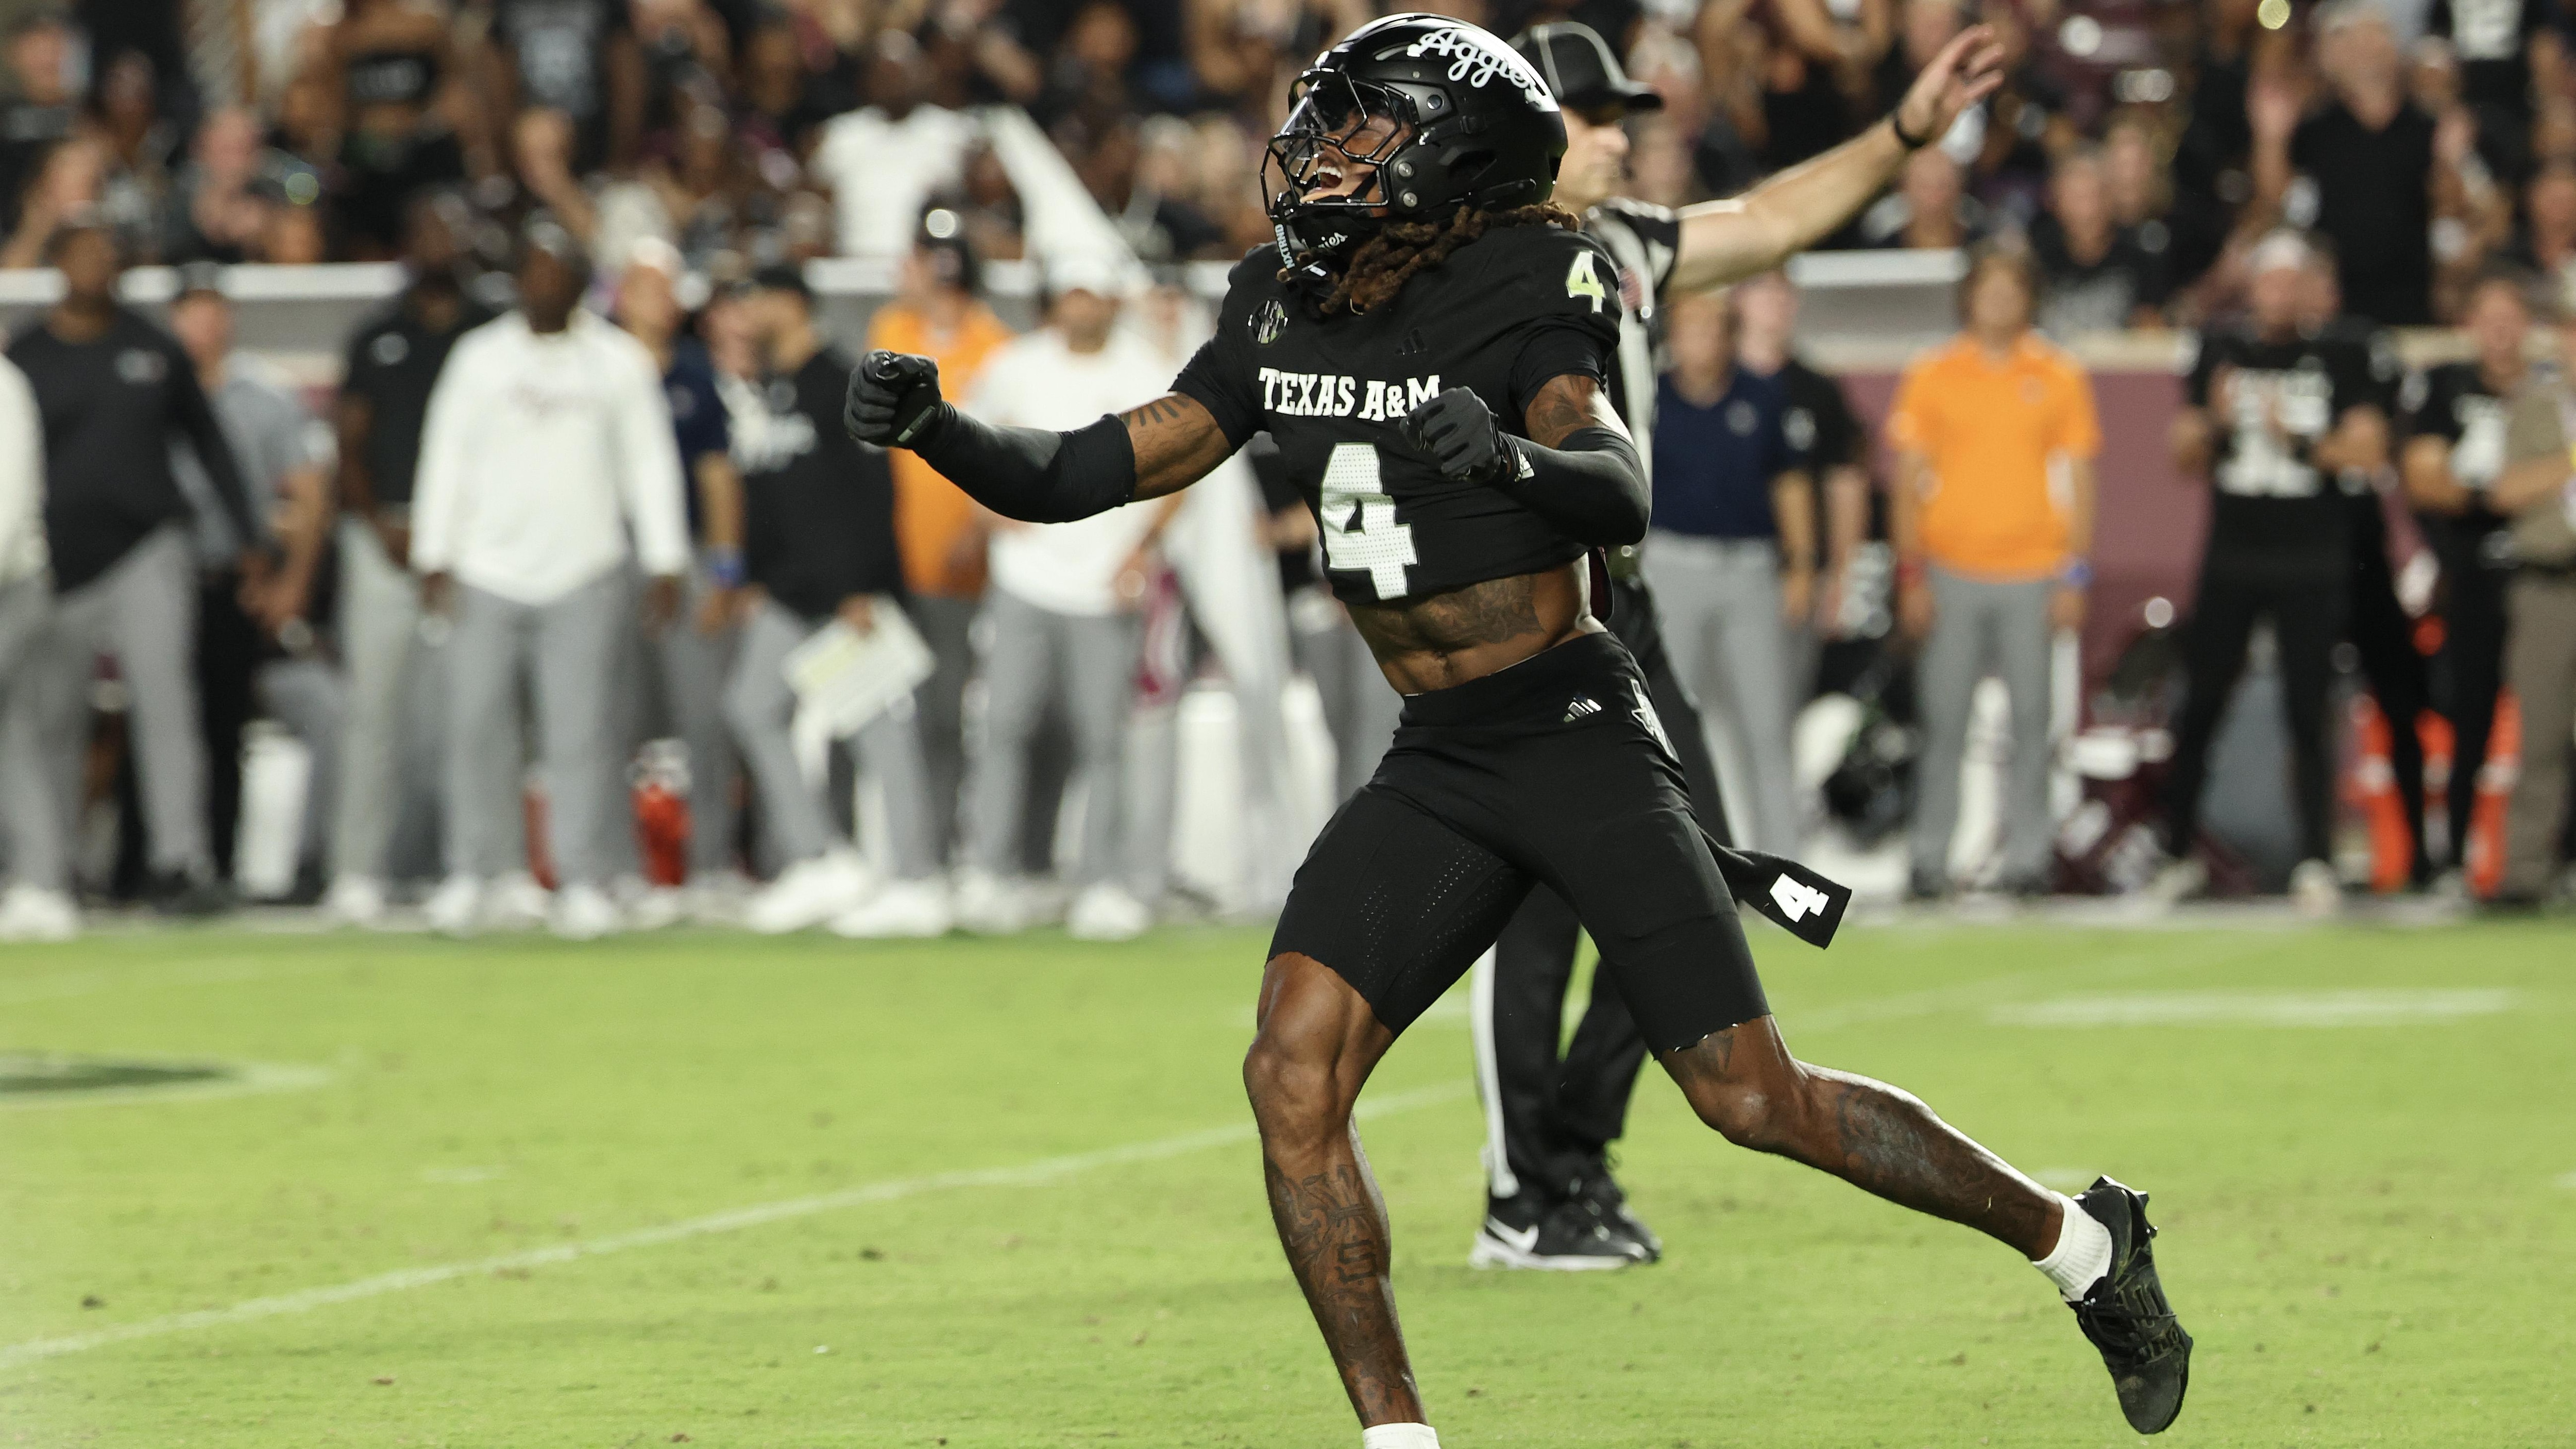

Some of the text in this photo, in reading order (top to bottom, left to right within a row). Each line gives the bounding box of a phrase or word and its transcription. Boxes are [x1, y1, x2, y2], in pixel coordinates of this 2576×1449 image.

[1407, 28, 1540, 106] Aggies
[1275, 224, 1295, 269] NXTRND
[1318, 232, 1348, 249] ies
[1565, 250, 1606, 313] 4
[1259, 367, 1440, 422] TEXAS A&M
[1320, 442, 1418, 600] 4
[1769, 872, 1829, 923] 4
